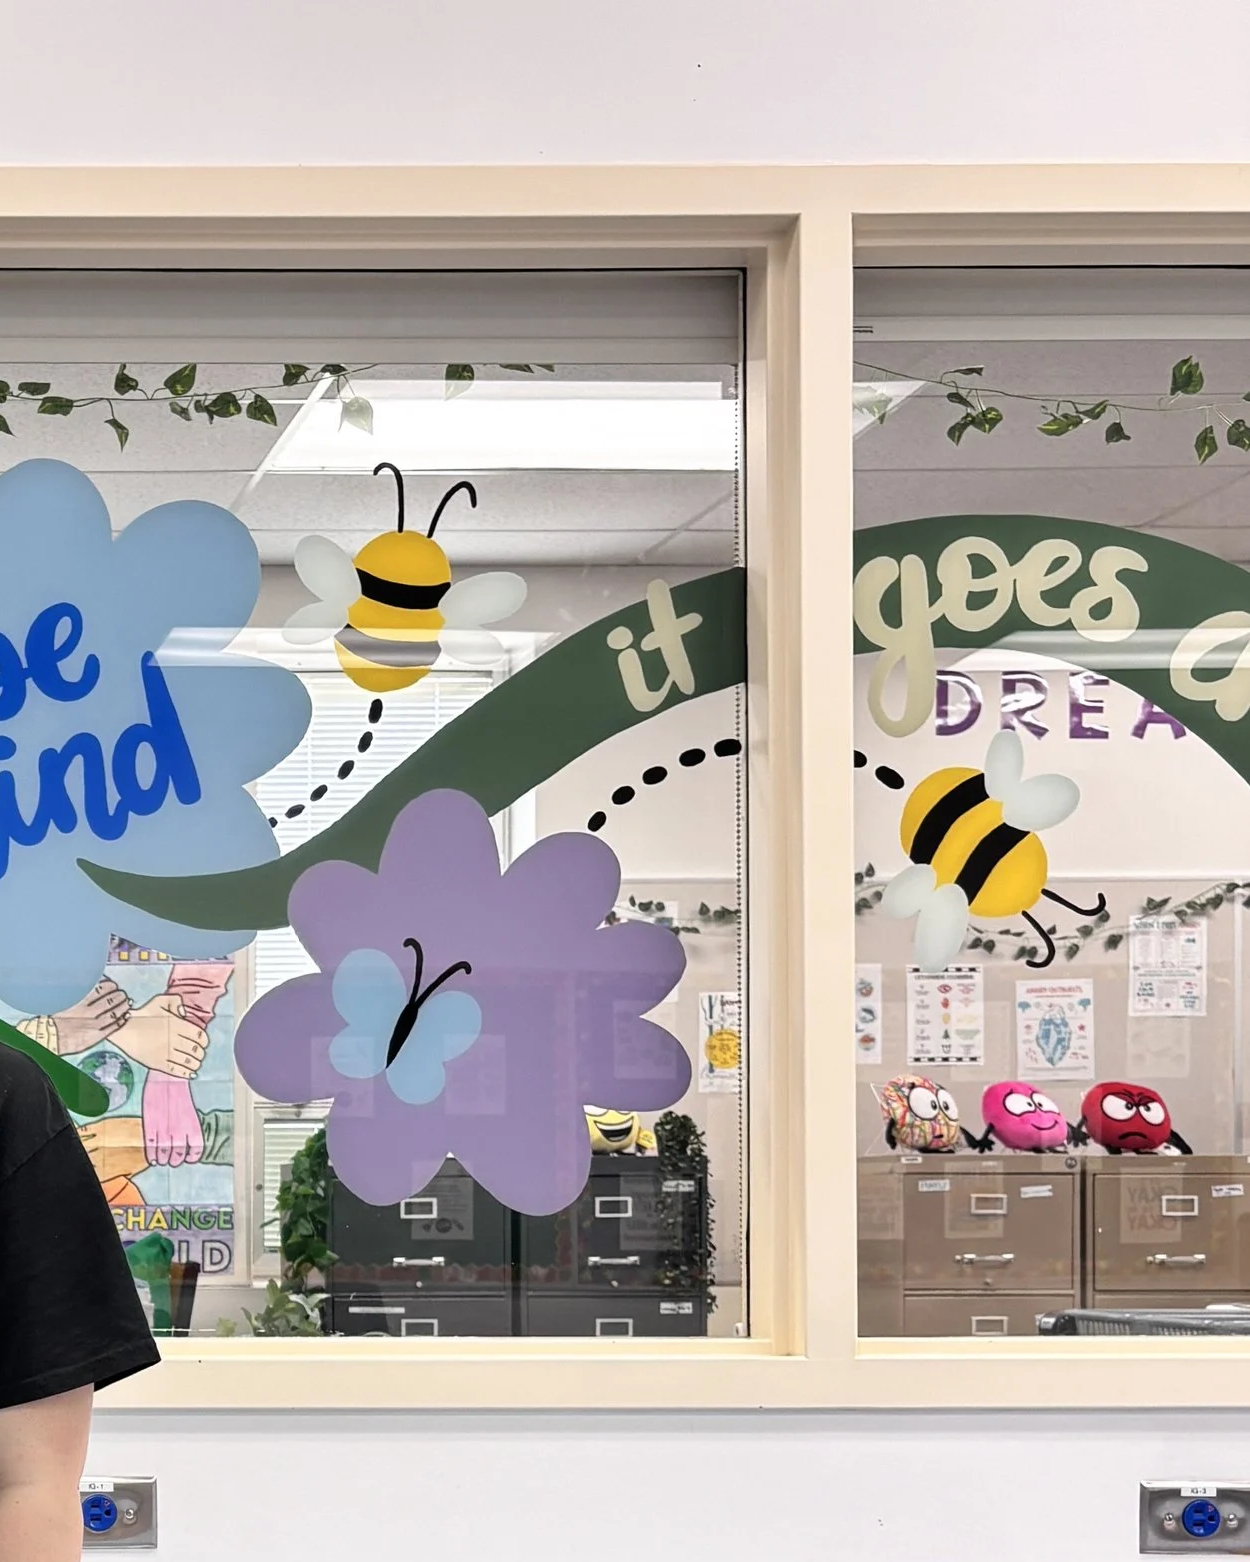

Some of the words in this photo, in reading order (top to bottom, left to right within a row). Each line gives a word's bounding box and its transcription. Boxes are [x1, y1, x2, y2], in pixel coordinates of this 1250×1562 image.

[606, 579, 703, 712] it
[853, 536, 1149, 738] goes
[935, 670, 1187, 740] DREA
[111, 1207, 234, 1230] CHANGE
